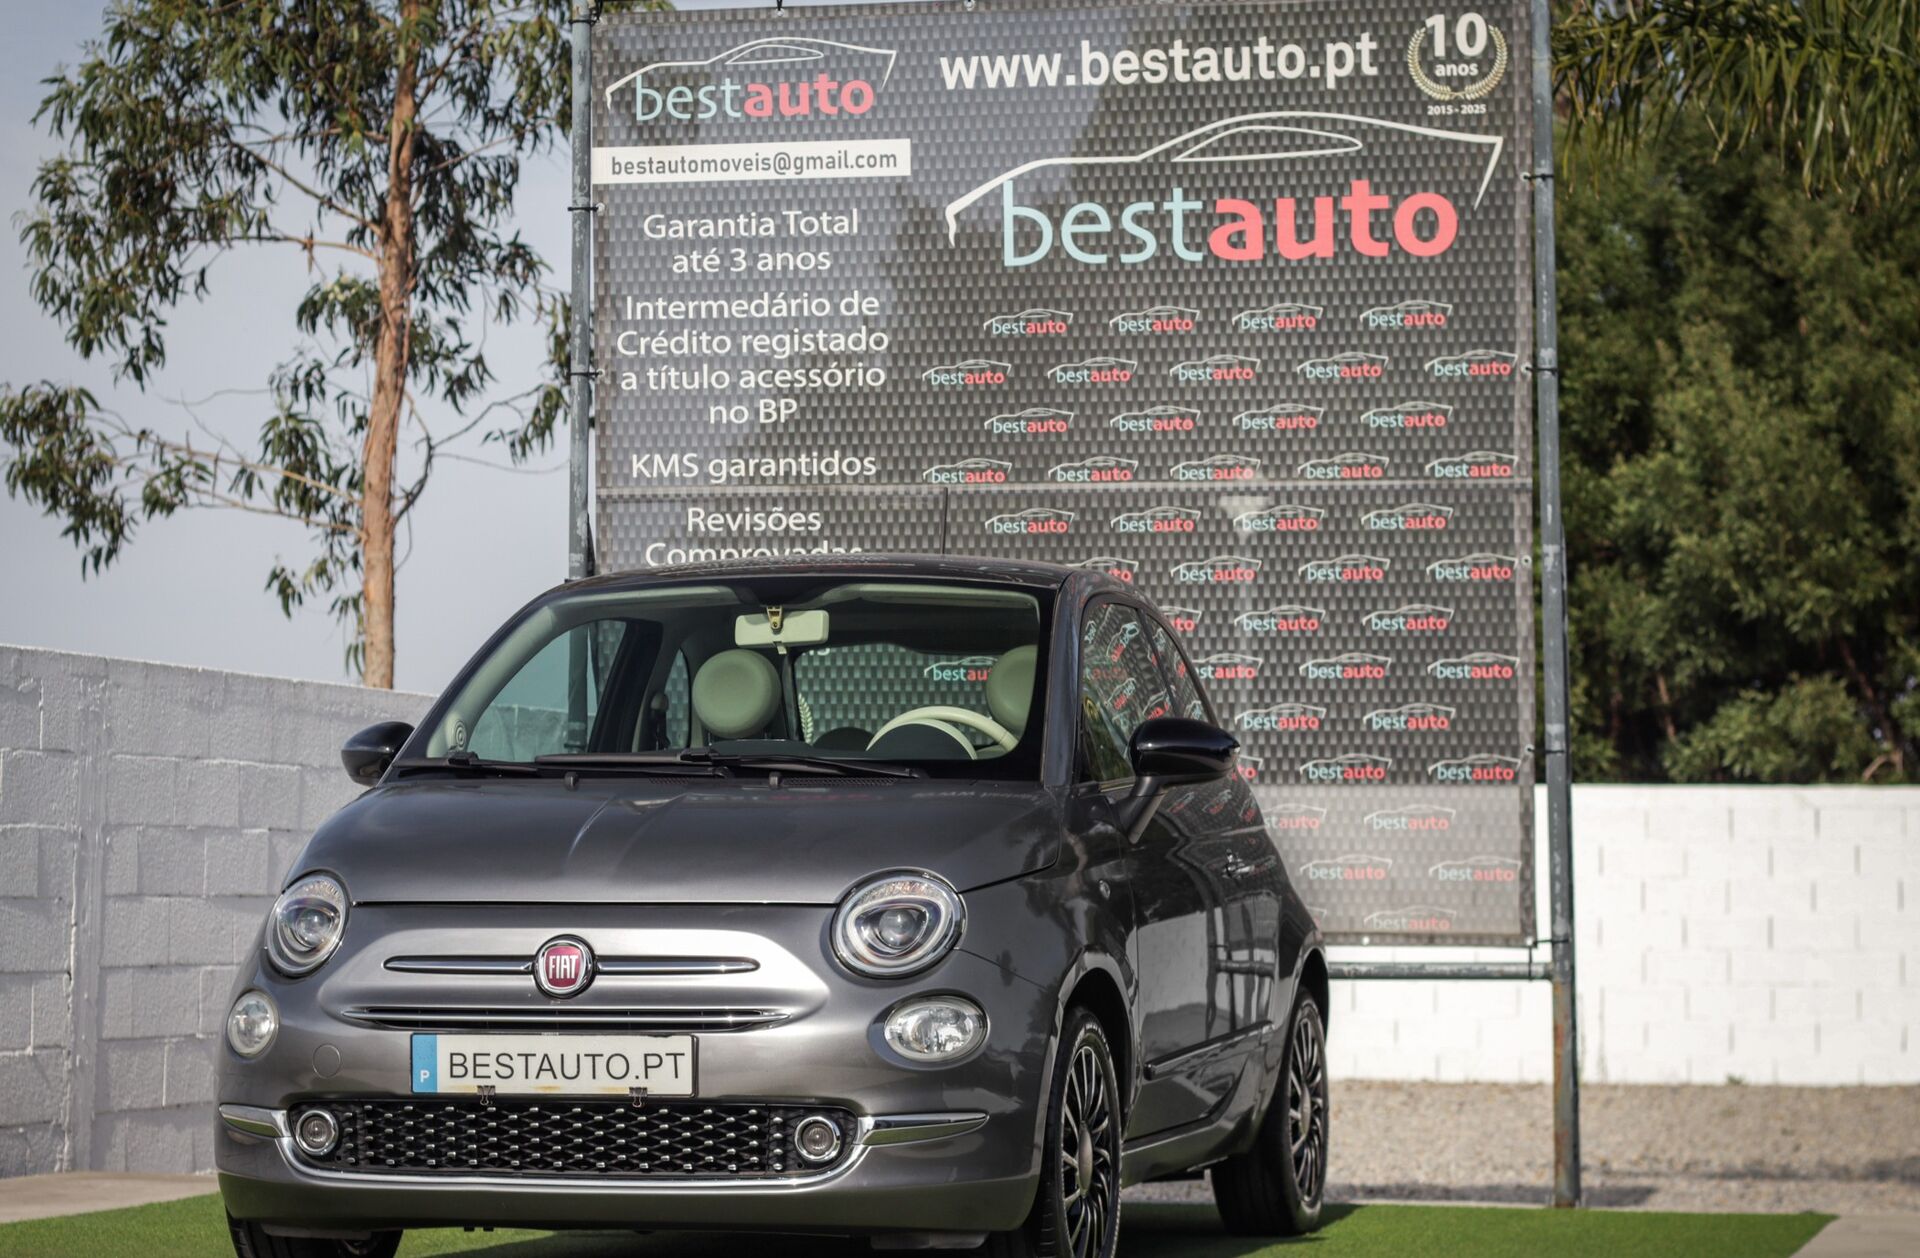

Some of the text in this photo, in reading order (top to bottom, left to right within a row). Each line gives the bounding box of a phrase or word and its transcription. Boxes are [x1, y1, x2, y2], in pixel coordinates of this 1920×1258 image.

[1425, 12, 1488, 57] 10
[940, 32, 1377, 90] www.bestauto.pt
[1435, 63, 1479, 77] anos
[636, 73, 874, 121] bestauto
[1427, 105, 1454, 116] 2015
[1461, 104, 1487, 115] 2025
[611, 150, 897, 175] bestautomoveis@gmail.com
[643, 208, 859, 239] Garantia Total
[1003, 179, 1458, 267] bestauto
[672, 248, 831, 273] até 3 anos
[625, 290, 880, 320] Intermedário de
[992, 320, 1069, 336] bestauto
[1117, 318, 1195, 334] bestauto
[1240, 314, 1317, 332] bestauto
[1367, 311, 1448, 329] bestauto
[617, 325, 889, 359] Crédito registado
[621, 362, 886, 390] a título acessório
[929, 369, 1007, 385] bestauto
[1055, 367, 1133, 383] bestauto
[1177, 364, 1256, 381] bestauto
[1305, 361, 1384, 380] bestauto
[1433, 360, 1513, 378] bestauto
[709, 399, 797, 424] no BP
[1368, 411, 1448, 429] bestauto
[992, 418, 1069, 435] bestauto
[1118, 416, 1196, 433] bestauto
[1241, 413, 1319, 431] bestauto
[632, 450, 877, 484] KMS garantidos
[930, 467, 1007, 485] bestauto
[1056, 466, 1134, 483] bestauto
[1178, 464, 1256, 482] bestauto
[1305, 463, 1384, 480] bestauto
[1433, 461, 1513, 479] bestauto
[687, 507, 822, 532] Revisões
[992, 517, 1070, 534] bestauto
[1119, 516, 1196, 533] bestauto
[1242, 514, 1320, 532] bestauto
[1369, 512, 1449, 531] bestauto
[1179, 565, 1257, 583] bestauto
[1306, 564, 1386, 582] bestauto
[1434, 563, 1514, 582] bestauto
[1242, 615, 1320, 632] bestauto
[1370, 613, 1450, 632] bestauto
[933, 664, 992, 682] bestau
[1195, 664, 1257, 679] stauto
[1307, 663, 1387, 681] bestauto
[1435, 662, 1515, 681] bestauto
[1242, 712, 1321, 731] bestauto
[1371, 711, 1451, 731] bestauto
[1307, 762, 1387, 781] bestauto
[1436, 762, 1516, 782] bestauto
[1264, 814, 1321, 830] stauto
[549, 954, 579, 979] FIAT
[420, 1052, 685, 1083] P BESTAUTO.PT
